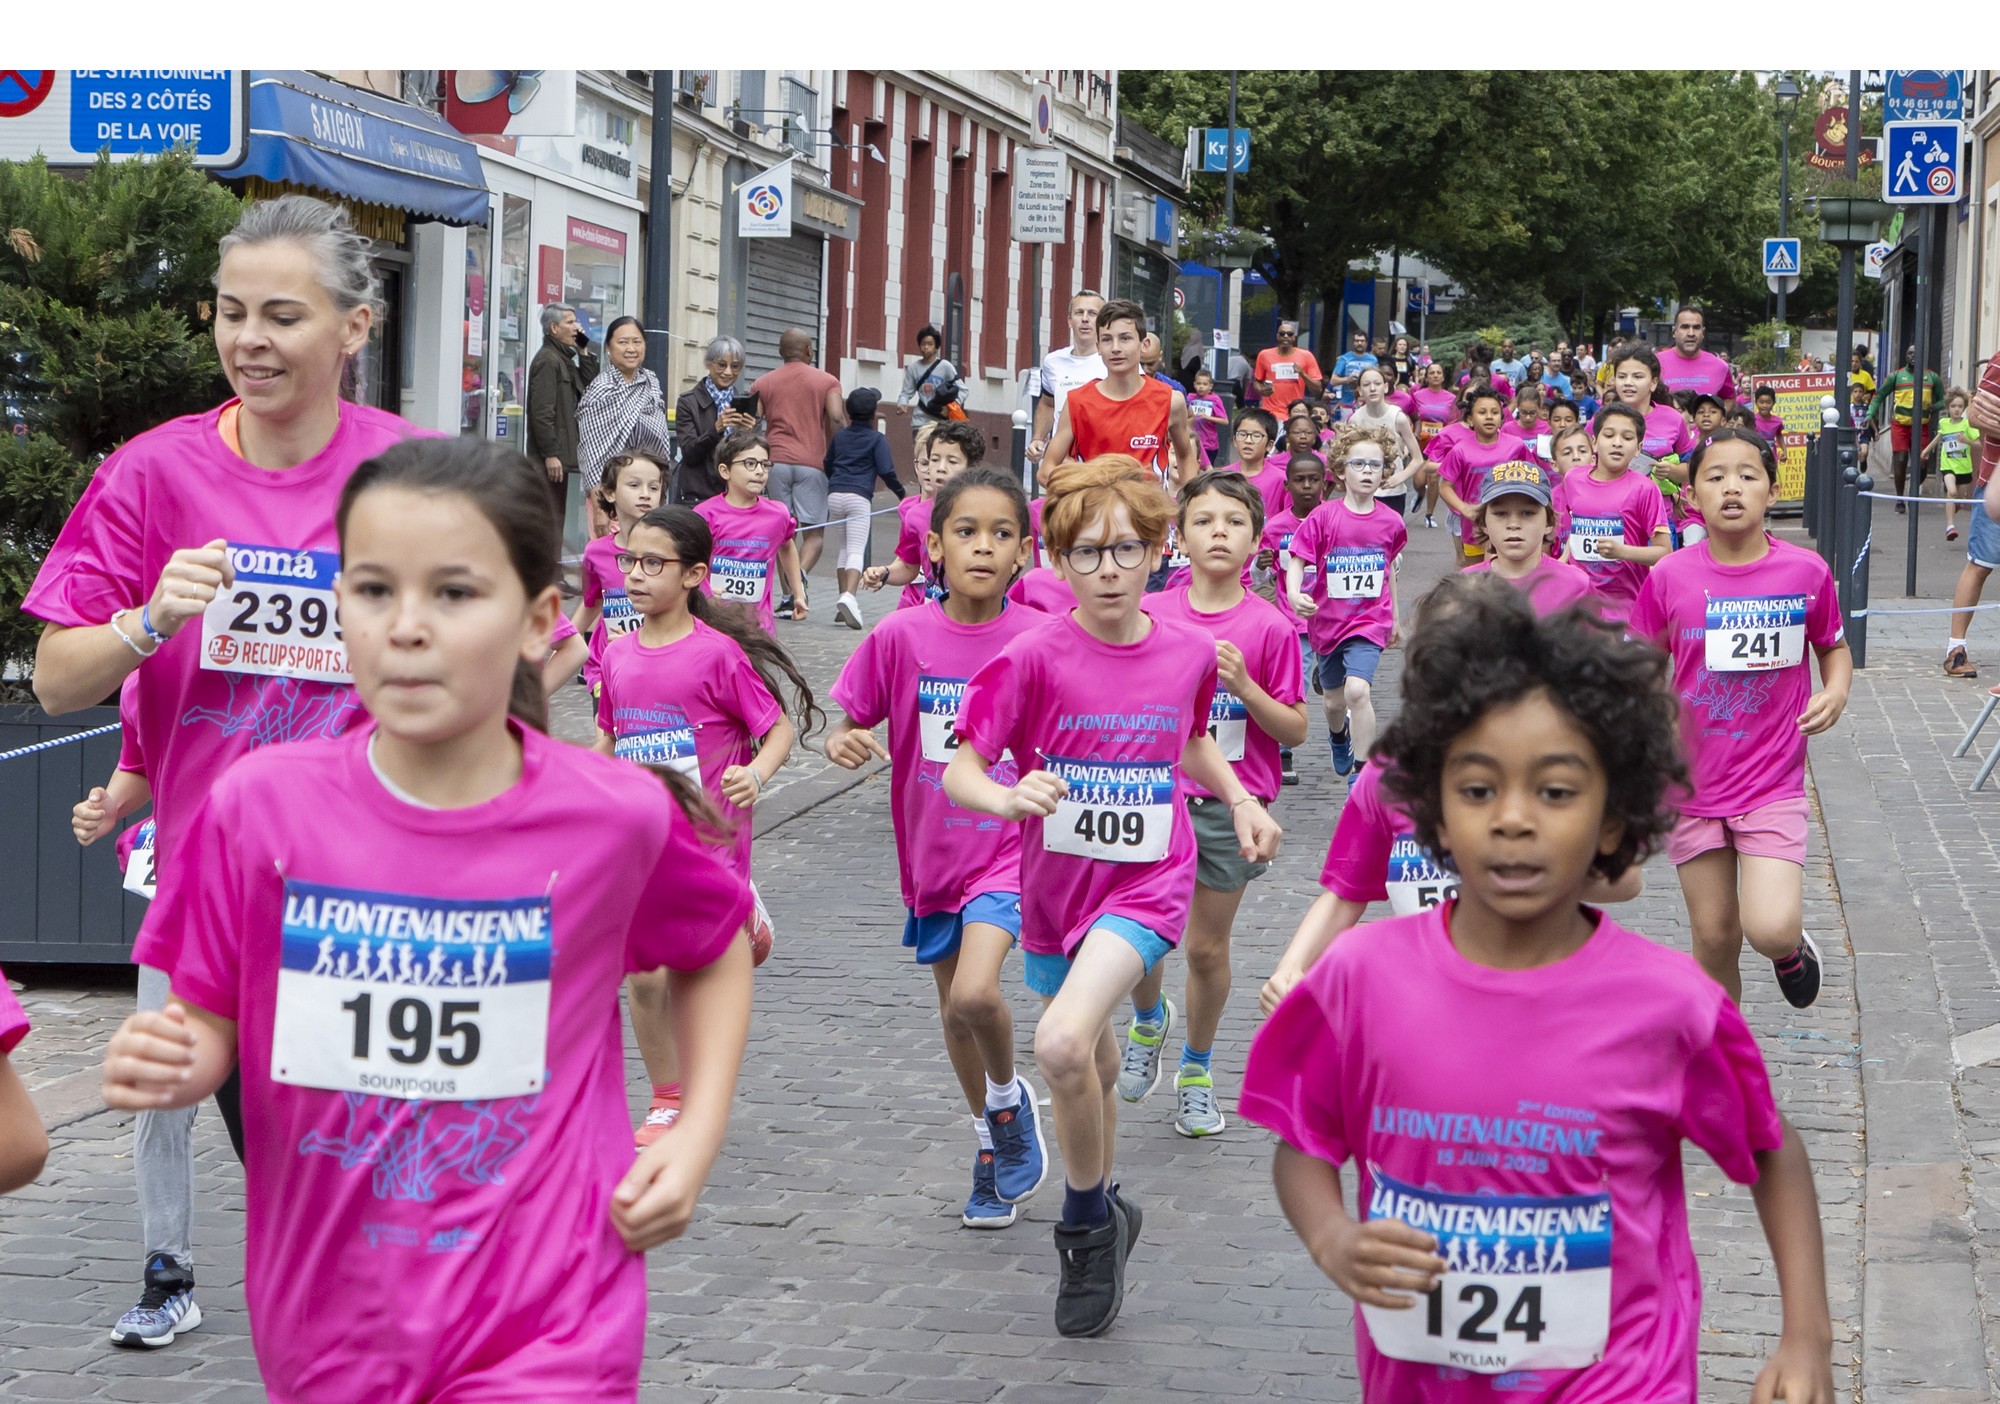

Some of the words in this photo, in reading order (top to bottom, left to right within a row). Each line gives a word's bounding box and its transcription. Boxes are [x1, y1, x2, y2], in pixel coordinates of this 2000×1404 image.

[90, 92, 126, 109] DES
[131, 93, 142, 109] 2
[147, 88, 211, 110] CÔTÉS
[1889, 98, 1900, 108] 01
[1917, 99, 1928, 109] 61
[1932, 100, 1943, 109] 10
[98, 122, 122, 139] DE
[128, 123, 152, 140] LA
[158, 124, 202, 140] VOIE
[310, 103, 365, 151] SAIGON
[1208, 142, 1243, 159] Krs
[1810, 154, 1868, 168] BOUCHIE
[1933, 176, 1948, 186] 20
[1756, 378, 1800, 389] GARAGE
[1807, 377, 1835, 388] L.R.M
[1492, 460, 1539, 476] SEVILLA
[1494, 472, 1504, 482] 12
[722, 559, 767, 569] FONTENAISIENNE
[1336, 553, 1384, 563] FONTENAISIENNE
[725, 578, 755, 596] 293
[1343, 575, 1374, 591] 174
[1707, 602, 1721, 613] LA
[1722, 598, 1805, 613] FONTENAISIENNE
[211, 636, 237, 656] R.S
[1732, 632, 1780, 659] 241
[920, 680, 931, 695] LA
[1058, 715, 1074, 730] LA
[1075, 714, 1179, 733] FONTENAISIENNE
[1100, 734, 1109, 742] 15
[1112, 734, 1132, 743] JUIN
[1134, 734, 1156, 743] 2025
[1046, 762, 1062, 779] LA
[1063, 763, 1171, 784] FONTENAISIENNE
[1074, 809, 1144, 846] 409
[284, 896, 315, 928] LA
[318, 900, 546, 944] FONTENAISIENNE
[341, 992, 480, 1067] 195
[358, 1074, 456, 1094] SOUNDOUS
[1373, 1106, 1395, 1134] LA
[1396, 1108, 1604, 1156] FONTENAISIENNE
[1437, 1148, 1454, 1165] 15
[1457, 1149, 1498, 1167] JUIN
[1503, 1153, 1548, 1174] 2025
[1370, 1188, 1395, 1218] LA
[1394, 1193, 1605, 1236] FONTENAISIENNE
[1427, 1280, 1546, 1343] 124
[1449, 1351, 1508, 1368] KYLIAN
